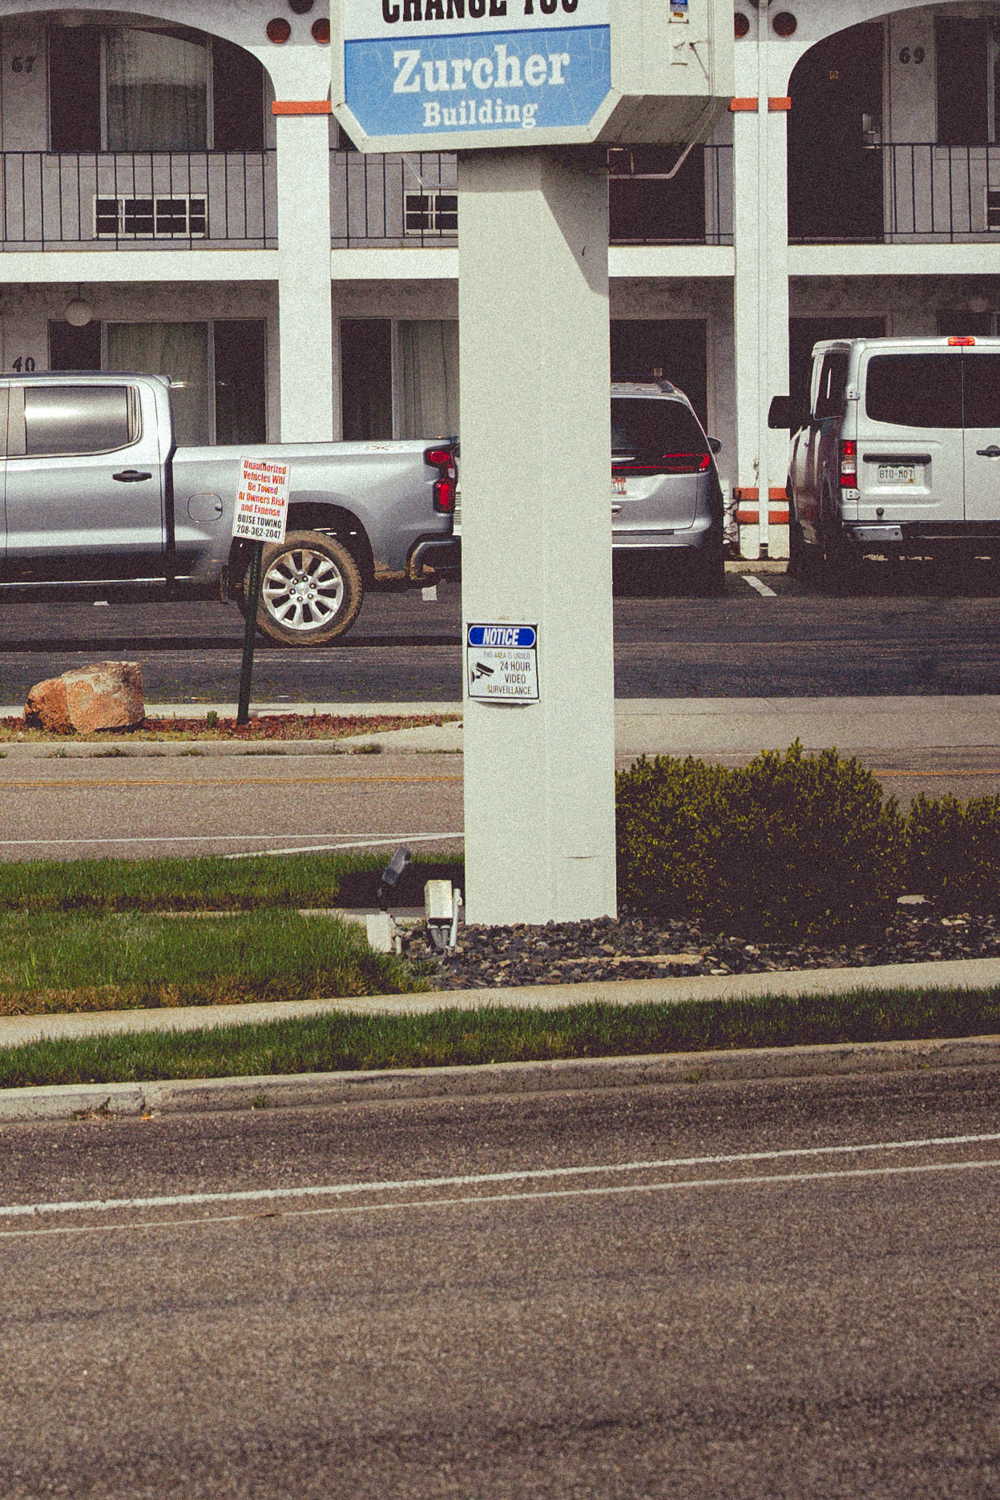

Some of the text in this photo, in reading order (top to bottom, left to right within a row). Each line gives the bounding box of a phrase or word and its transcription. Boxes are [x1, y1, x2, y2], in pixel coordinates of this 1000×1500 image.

[899, 45, 925, 65] 69
[11, 55, 36, 74] 67
[393, 43, 571, 95] Zurcher
[422, 98, 539, 130] Building
[12, 356, 36, 373] 40
[243, 460, 287, 475] Unauthorized
[243, 470, 286, 485] Vehicles Will
[247, 482, 279, 495] Be Towed
[246, 492, 271, 505] Owners
[271, 497, 286, 507] Risk
[241, 503, 280, 517] and Expense
[237, 513, 282, 529] BOISE TOWING
[482, 627, 520, 646] NOTICE
[500, 661, 531, 672] 24 HOUR
[504, 673, 527, 684] VIDEO
[487, 685, 532, 695] SURVEILLANCE
